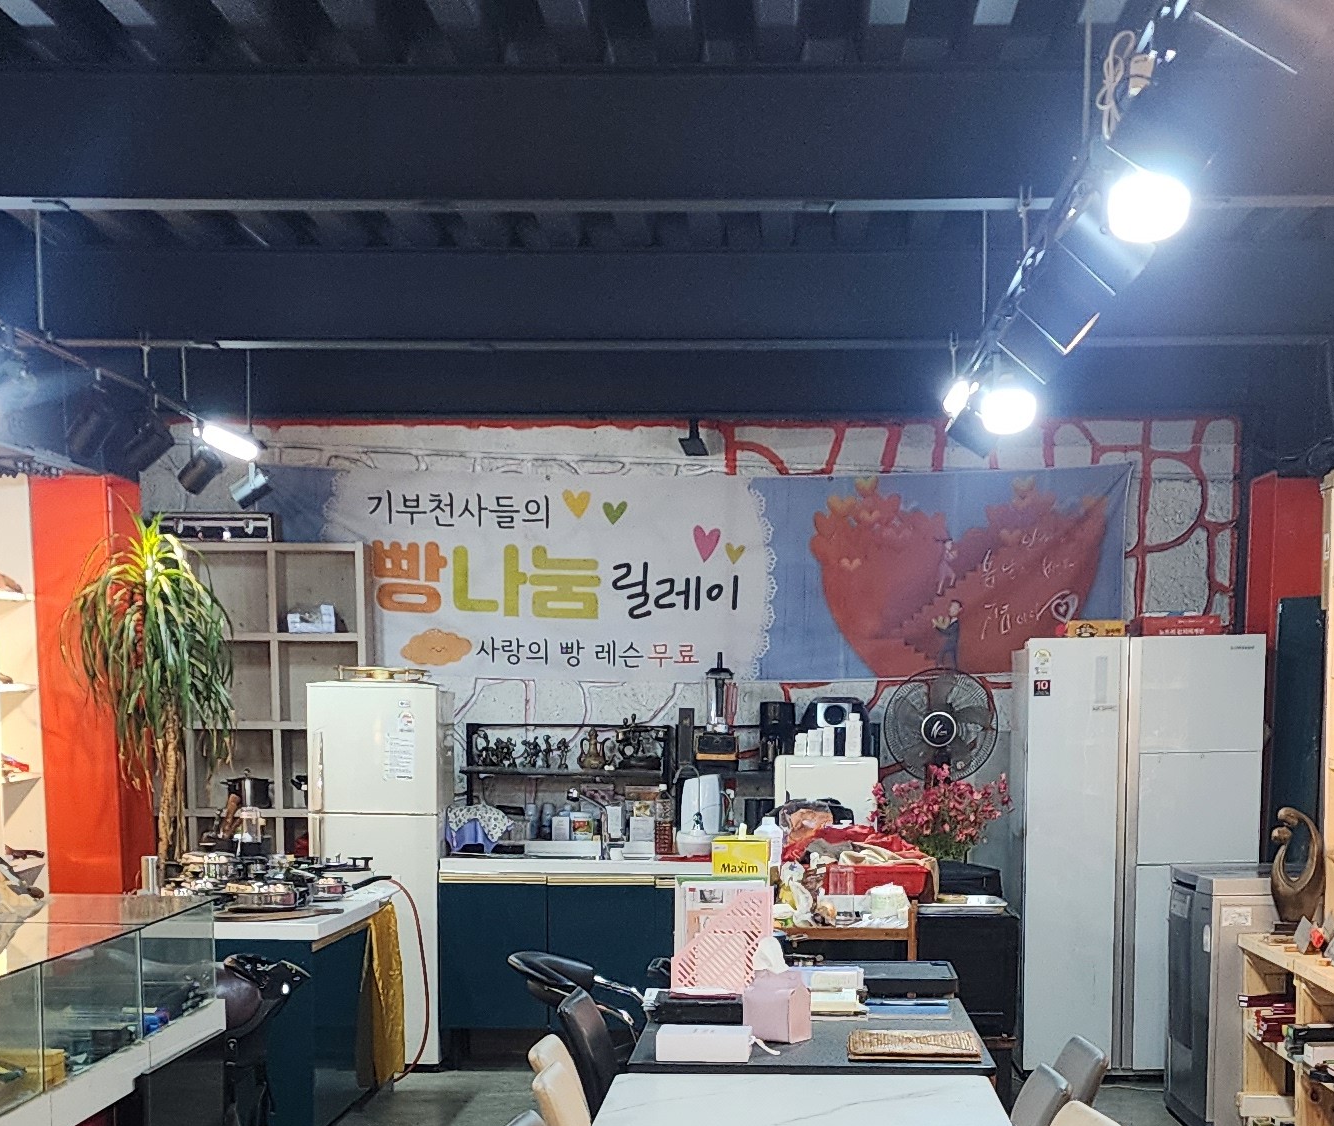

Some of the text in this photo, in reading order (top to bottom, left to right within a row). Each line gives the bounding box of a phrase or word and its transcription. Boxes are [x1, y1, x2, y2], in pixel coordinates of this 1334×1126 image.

[368, 490, 550, 528] 기부천사들의
[372, 540, 739, 619] 빵나눔 릴레이
[476, 637, 549, 666] 사랑의
[560, 641, 585, 667] 빵
[1035, 681, 1048, 690] 10
[721, 861, 758, 873] Maxim
